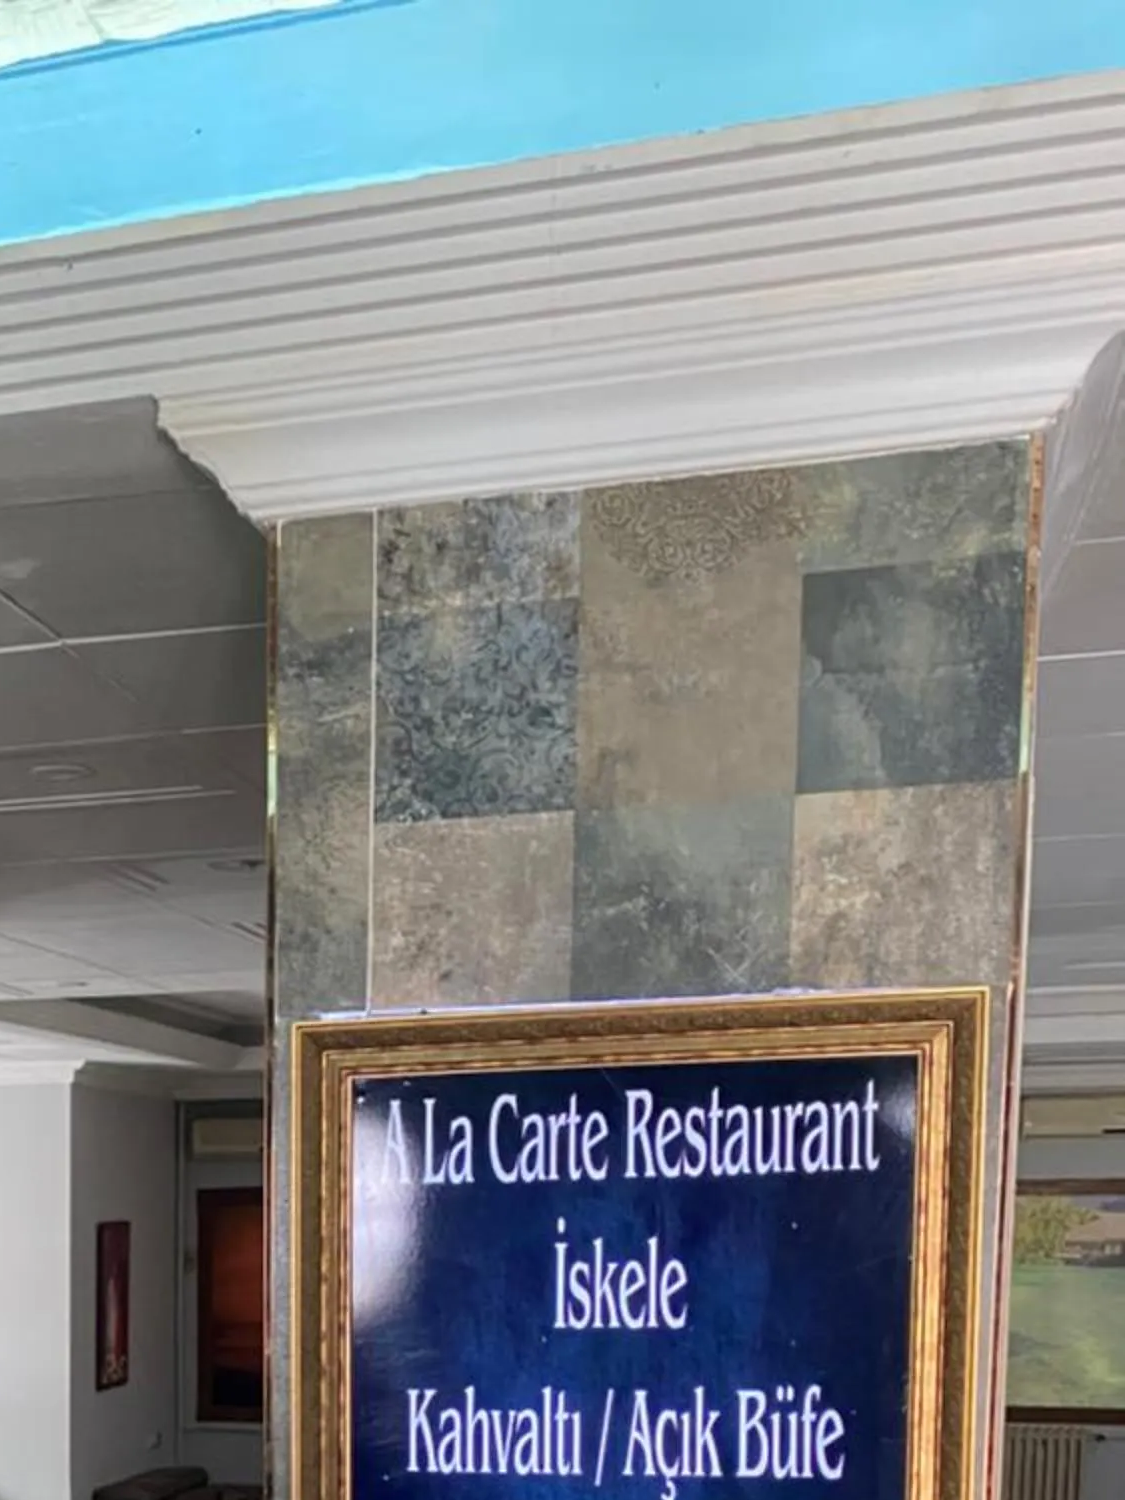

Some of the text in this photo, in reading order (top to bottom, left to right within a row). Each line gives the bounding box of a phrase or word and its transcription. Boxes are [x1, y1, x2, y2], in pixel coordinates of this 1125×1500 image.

[380, 1080, 880, 1184] A La Carte Restaurant
[553, 1217, 689, 1329] İskele
[406, 1387, 582, 1475] Kahvaltı
[593, 1388, 615, 1486] /
[735, 1383, 846, 1479] Büfe
